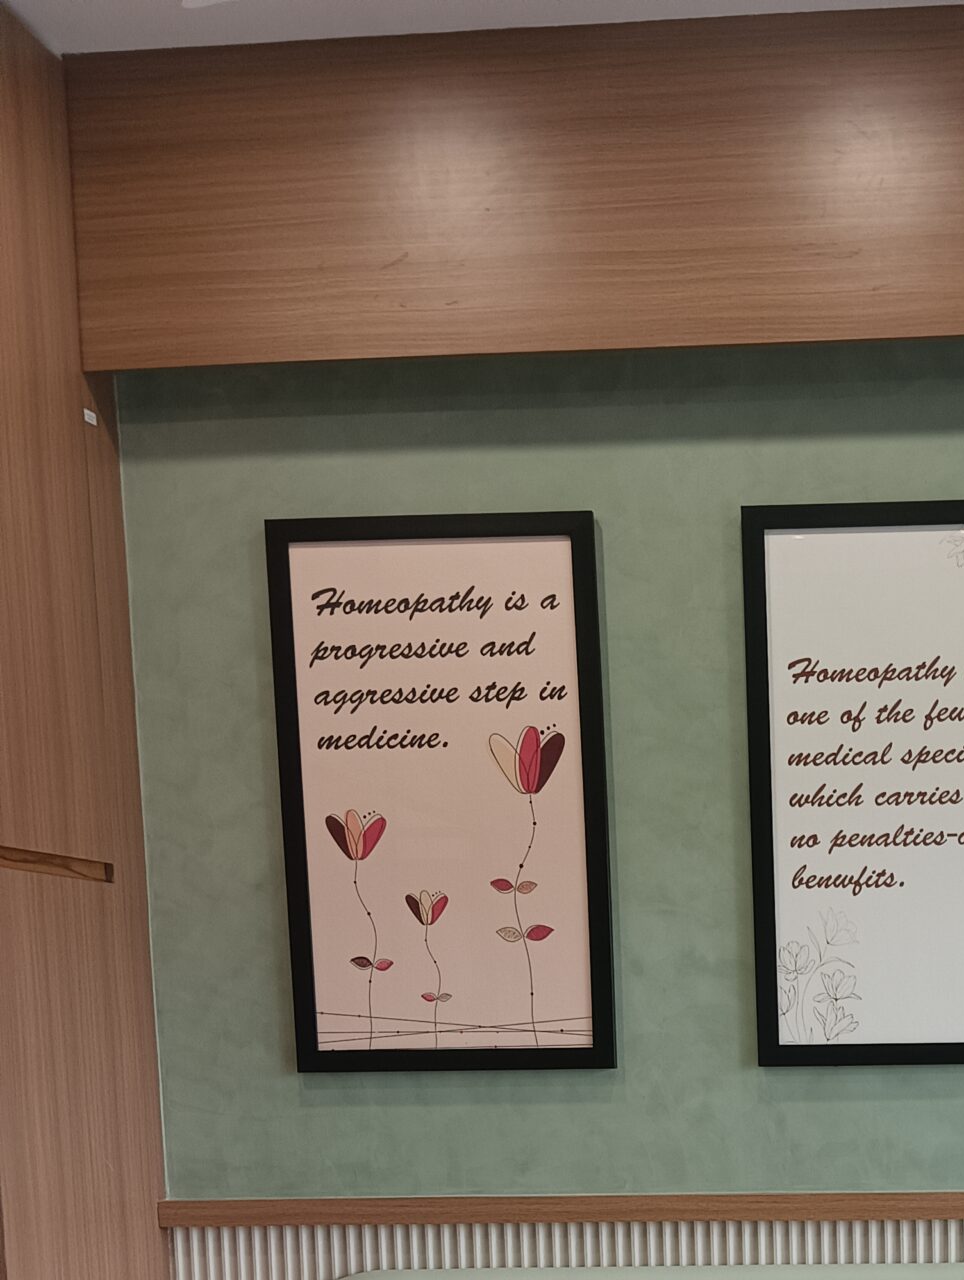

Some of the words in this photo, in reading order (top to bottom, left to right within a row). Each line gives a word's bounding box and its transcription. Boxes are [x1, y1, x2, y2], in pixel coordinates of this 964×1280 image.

[311, 586, 493, 621] Homeopathy
[505, 591, 529, 611] is
[540, 594, 560, 611] a
[309, 638, 469, 669] progressive
[480, 632, 536, 657] and
[788, 656, 956, 688] Homeopathy
[314, 684, 459, 714] aggressive
[469, 681, 527, 709] step
[539, 681, 567, 701] in
[787, 710, 829, 725] one
[840, 701, 867, 732] of
[875, 699, 915, 724] the
[317, 725, 449, 750] medicine.
[788, 742, 893, 766] medical
[789, 783, 864, 807] which
[875, 787, 963, 806] carries
[790, 833, 820, 848] no
